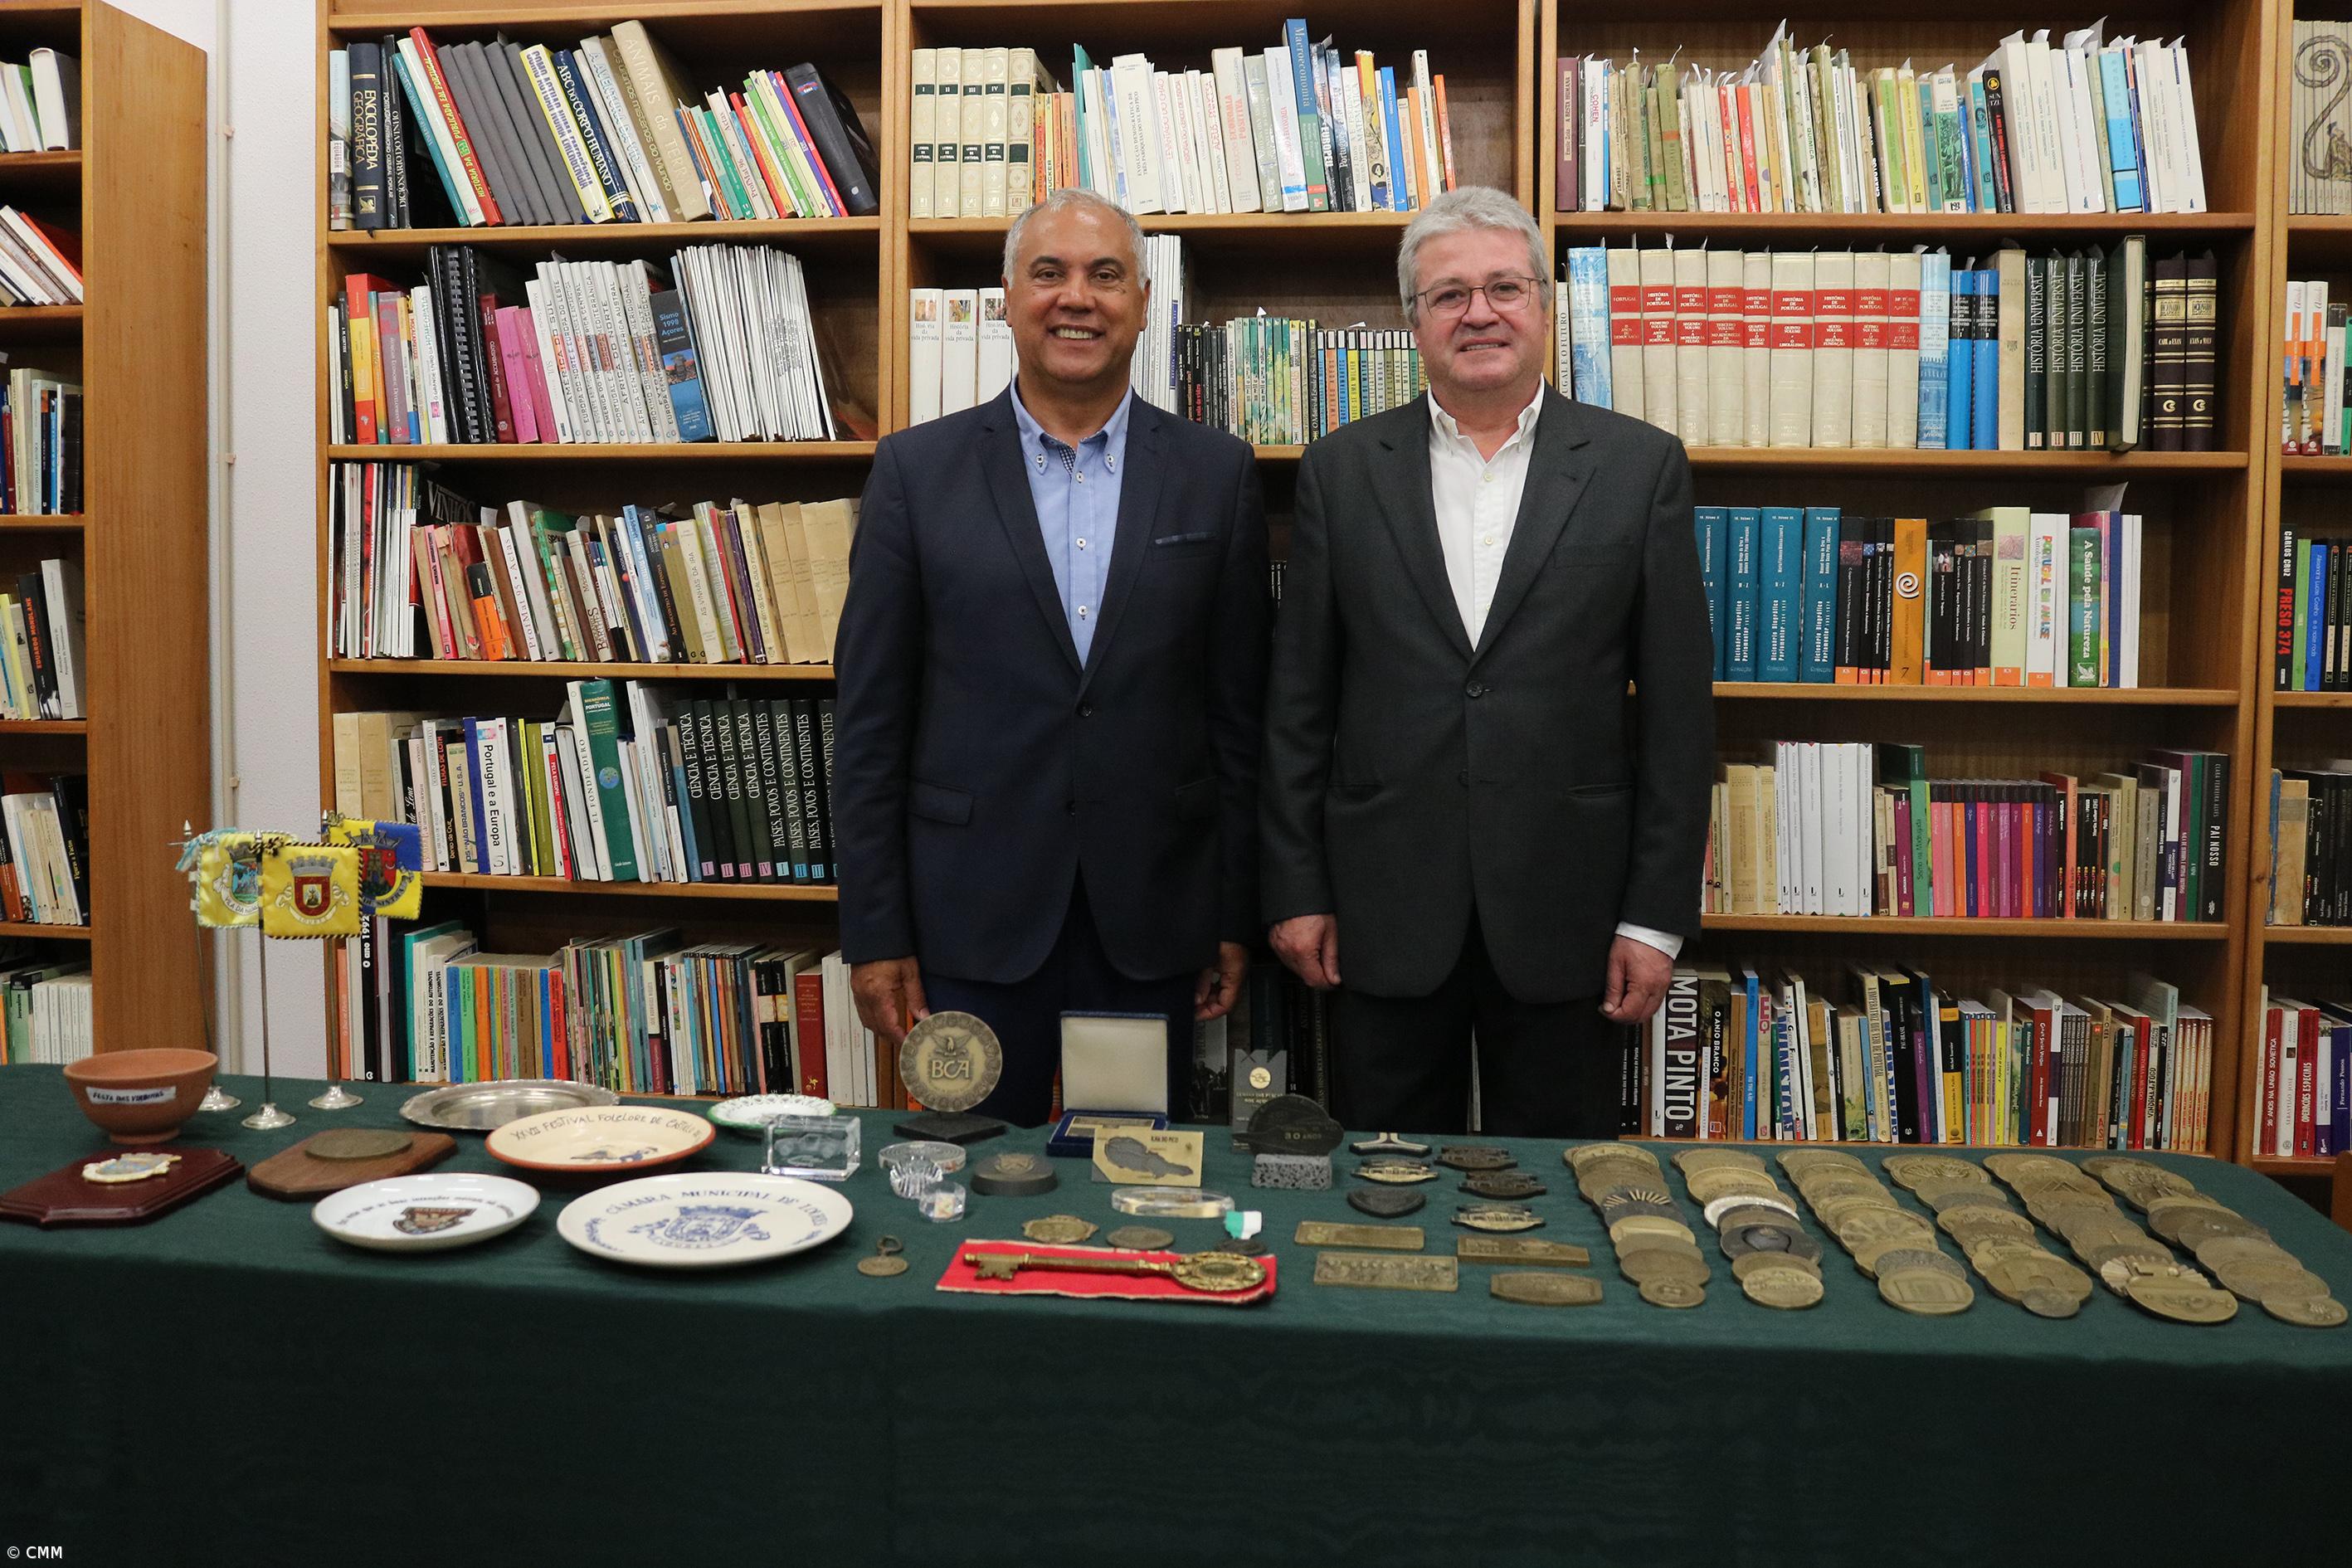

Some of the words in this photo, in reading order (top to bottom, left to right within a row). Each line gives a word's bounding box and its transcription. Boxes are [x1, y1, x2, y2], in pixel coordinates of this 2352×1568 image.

[424, 56, 443, 90] PORTUGAL
[627, 38, 661, 105] ANIMAIS
[1293, 26, 1310, 107] Macroeconomia
[353, 90, 365, 164] GEOGRÁFICA
[364, 89, 378, 170] ENCICLOPÉDIA
[440, 102, 462, 140] PUBLICADA
[558, 65, 575, 90] ABC
[572, 100, 593, 137] CORPO
[587, 135, 613, 187] HUMANO
[1322, 124, 1335, 168] EUROPEU
[659, 312, 679, 321] Sismo
[2031, 273, 2043, 326] UNIVERSAL
[2052, 272, 2064, 326] UNIVERSAL
[2071, 271, 2083, 324] UNIVERSAL
[2093, 271, 2106, 324] UNIVERSAL
[661, 326, 684, 336] Açores
[1559, 311, 1567, 352] FUTURO
[2067, 327, 2083, 373] HISTÓRIA
[2090, 327, 2106, 373] HISTÓRIA
[2028, 328, 2043, 373] HISTÓRIA
[2049, 328, 2064, 373] HISTÓRIA
[2054, 433, 2062, 446] II
[2071, 432, 2081, 445] III
[2092, 432, 2103, 445] IV
[2084, 540, 2093, 549] A
[2283, 531, 2292, 557] CARLOS
[2084, 553, 2094, 582] Saúde
[2283, 558, 2291, 577] CRUZ
[2082, 586, 2092, 605] pela
[2279, 587, 2293, 626] PRESO
[2082, 607, 2092, 659] Natureza
[2277, 631, 2292, 655] 374
[679, 713, 694, 750] TÉCNICA
[699, 713, 713, 752] TÉCNICA
[718, 713, 733, 752] TÉCNICA
[738, 713, 752, 751] TÉCNICA
[756, 713, 775, 777] CONTINENTES
[776, 713, 796, 777] CONTINENTES
[796, 714, 815, 778] CONTINENTES
[484, 744, 494, 788] Portugal
[489, 810, 499, 847] Europa
[688, 760, 703, 798] CIÊNCIA
[707, 762, 723, 800] CIÊNCIA
[725, 762, 741, 800] CIÊNCIA
[745, 761, 760, 799] CIÊNCIA
[768, 787, 781, 817] POVOS
[787, 788, 800, 818] POVOS
[806, 788, 818, 818] POVOS
[2210, 825, 2220, 842] PAI
[705, 863, 711, 874] I
[723, 864, 732, 876] II
[741, 864, 751, 876] III
[760, 863, 772, 874] IV
[779, 863, 786, 875] I
[796, 865, 806, 876] II
[813, 865, 824, 877] III
[2209, 845, 2220, 867] NOSSO
[362, 915, 371, 937] 1992
[1667, 976, 1697, 1040] MOTA
[932, 1059, 970, 1079] BCA
[1712, 1041, 1721, 1074] BRANCO
[2302, 1062, 2312, 1090] ESPECIAIS
[1665, 1050, 1697, 1121] PINTO
